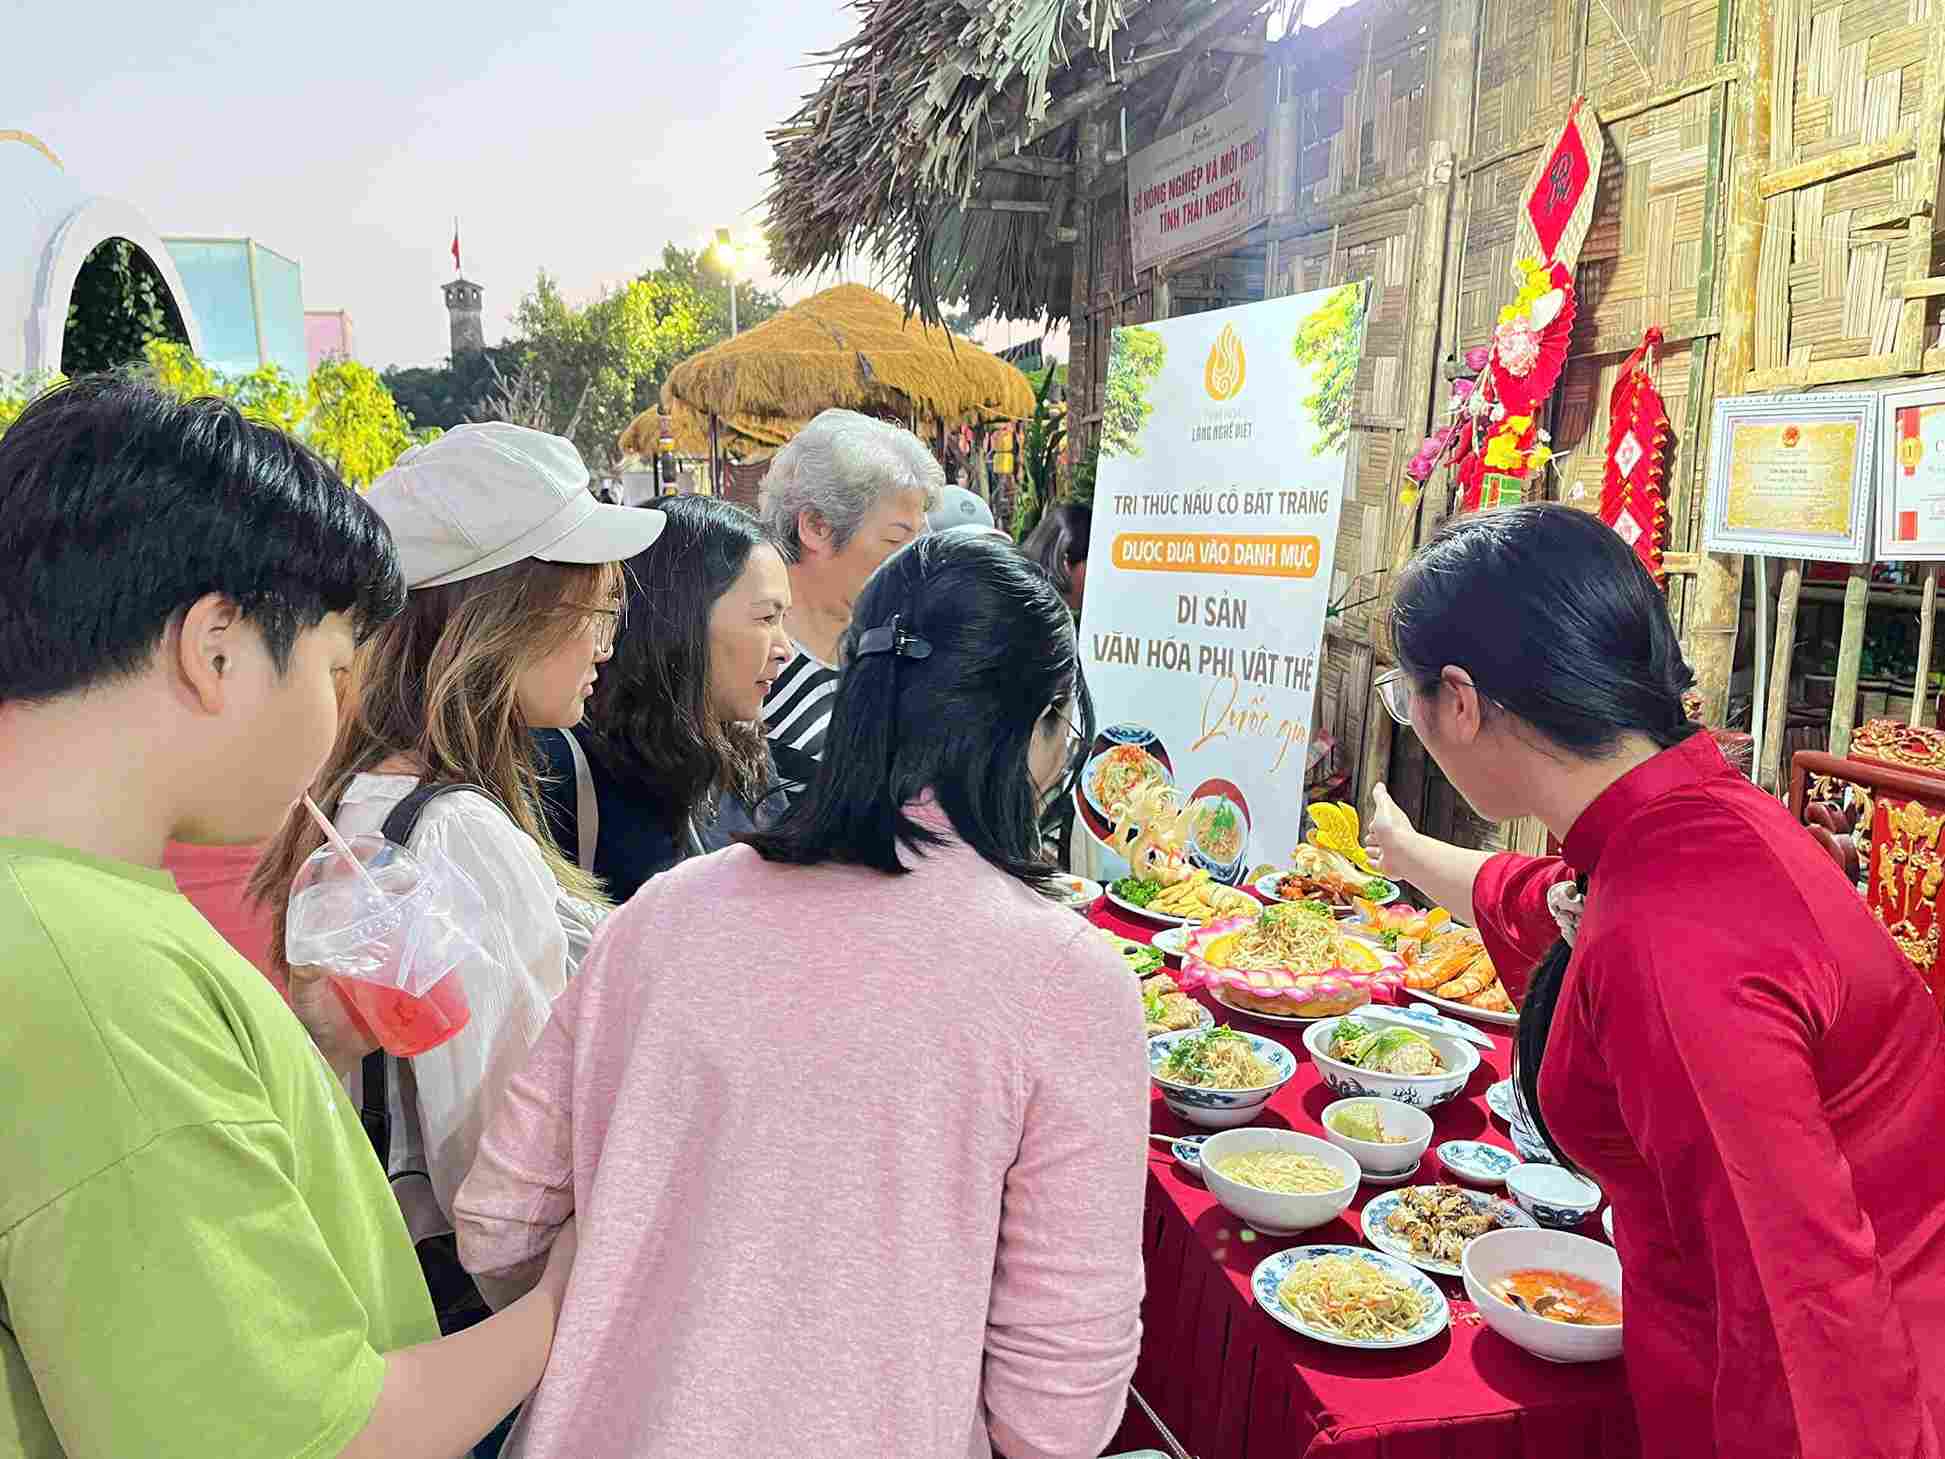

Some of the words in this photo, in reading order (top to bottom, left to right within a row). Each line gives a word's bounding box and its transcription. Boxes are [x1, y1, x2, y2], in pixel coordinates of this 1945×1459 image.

[1113, 495, 1137, 515] TRI
[1182, 485, 1213, 515] NẤU
[1199, 538, 1231, 566] VÀO
[1233, 543, 1277, 568] DANH
[1177, 594, 1198, 625] DI
[1204, 589, 1248, 630] SẢN
[1093, 630, 1140, 665] VĂN
[1146, 634, 1192, 673] HÓA
[1199, 645, 1235, 679] PHI
[1241, 644, 1280, 688] VẬT
[1283, 643, 1315, 693] THỂ
